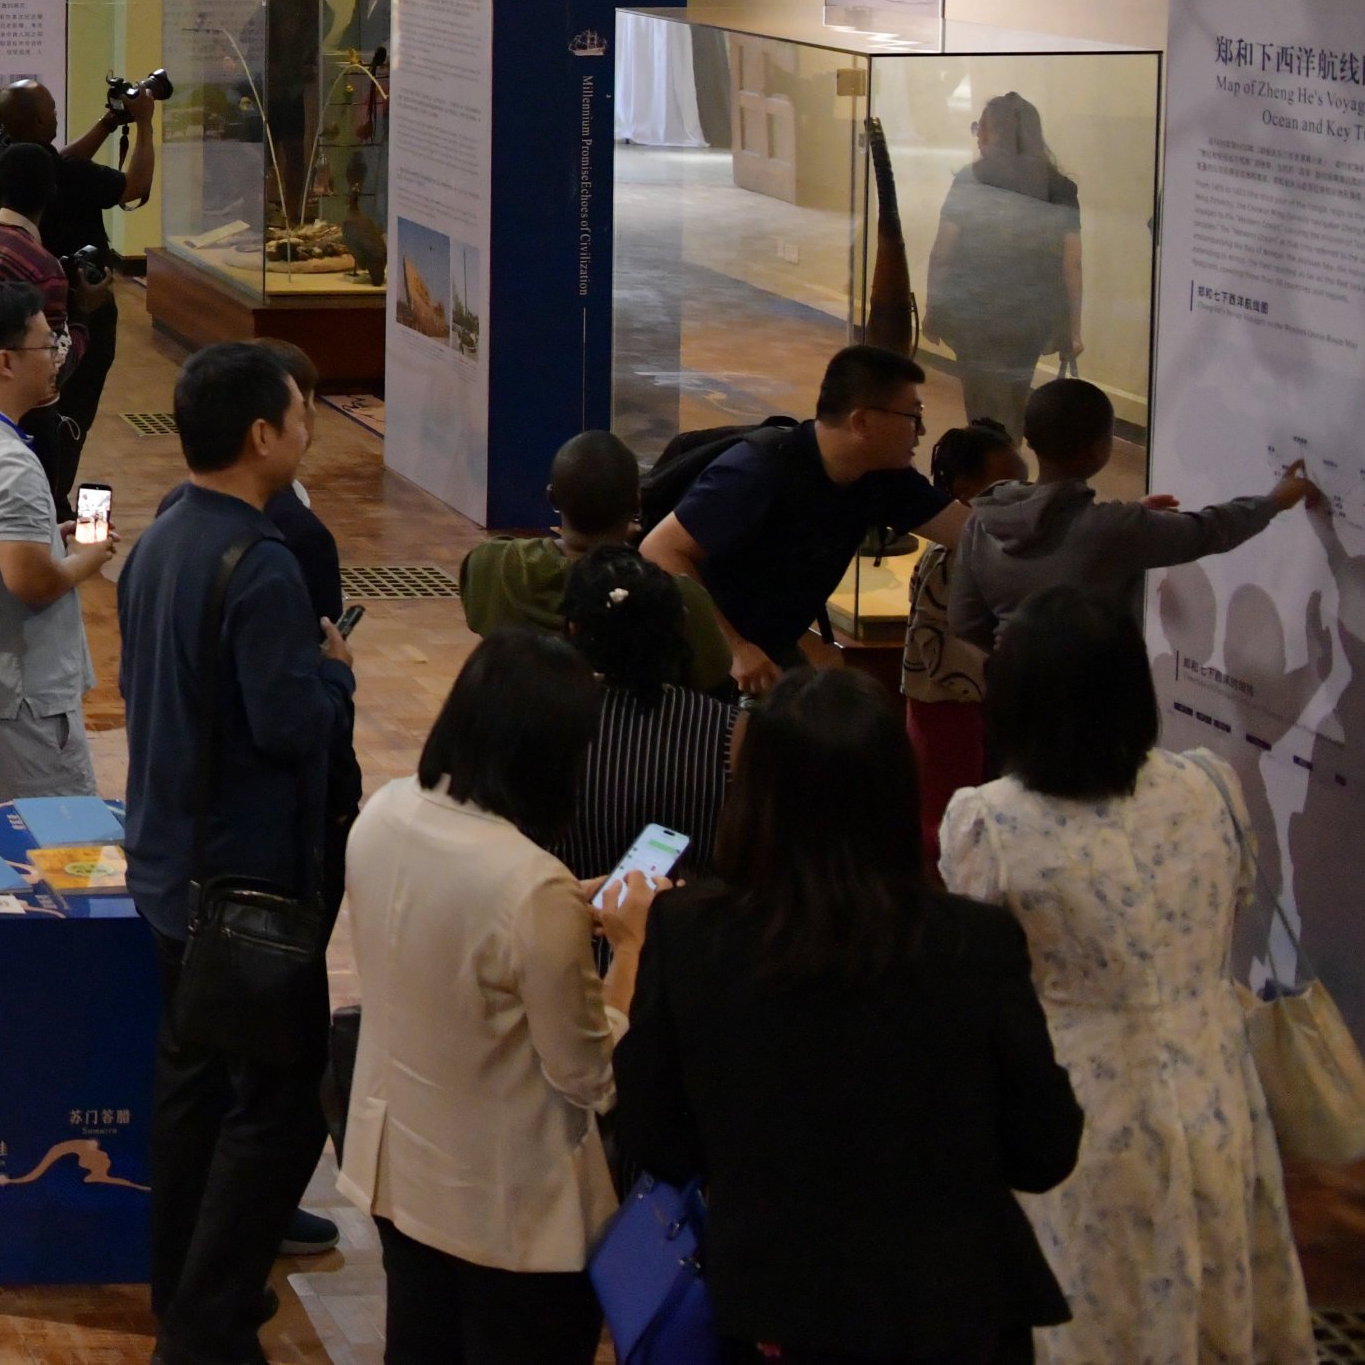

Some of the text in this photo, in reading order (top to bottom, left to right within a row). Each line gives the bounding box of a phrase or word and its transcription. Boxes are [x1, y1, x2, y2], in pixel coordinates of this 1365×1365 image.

[1215, 36, 1365, 85] 郑和下西洋航线
[581, 75, 593, 134] Millennium
[1215, 75, 1240, 96] Map
[1243, 78, 1255, 95] of
[1257, 81, 1293, 105] Zheng
[1297, 87, 1322, 106] He's
[1262, 109, 1298, 129] Ocean
[1301, 115, 1322, 134] and
[1326, 120, 1350, 142] Key
[579, 220, 591, 231] of
[579, 233, 592, 296] Civilization
